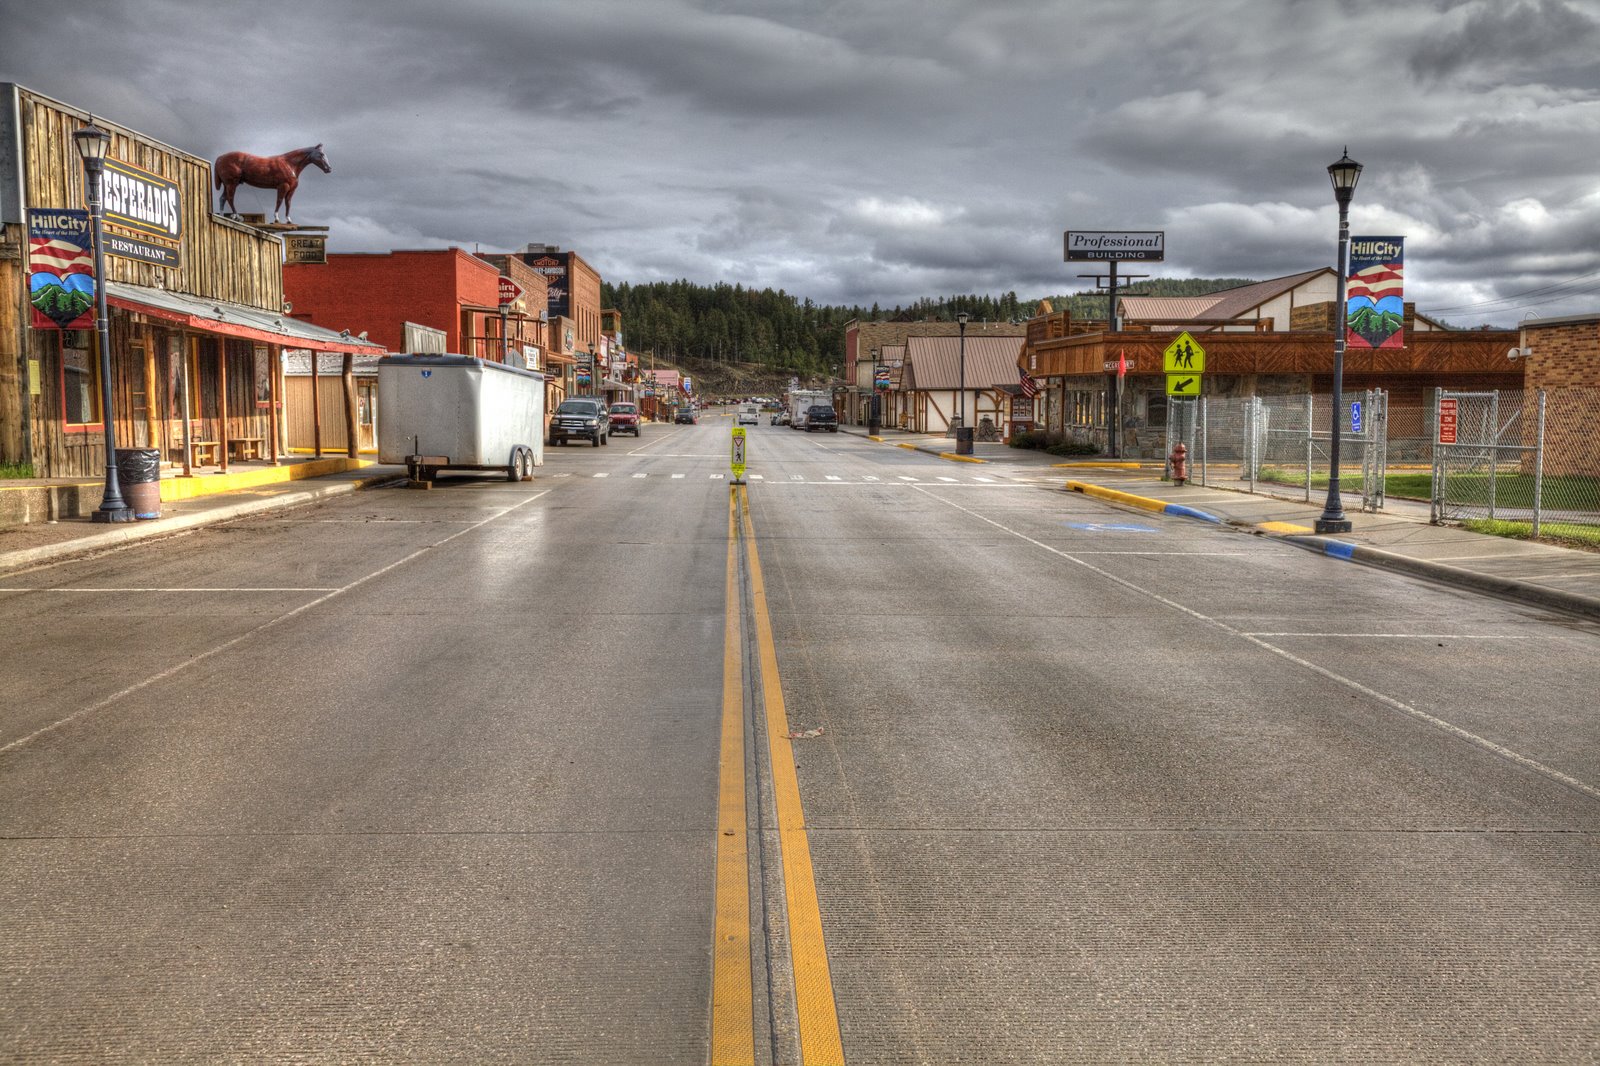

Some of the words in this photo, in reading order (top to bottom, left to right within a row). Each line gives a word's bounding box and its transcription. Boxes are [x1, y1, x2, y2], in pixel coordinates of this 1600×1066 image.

[290, 239, 320, 248] GREAT
[1073, 235, 1159, 249] Professional
[111, 239, 166, 261] RESTAURANT
[293, 250, 317, 259] FOOD
[1087, 251, 1145, 259] BUILDING
[498, 282, 515, 292] airy
[498, 291, 515, 299] een
